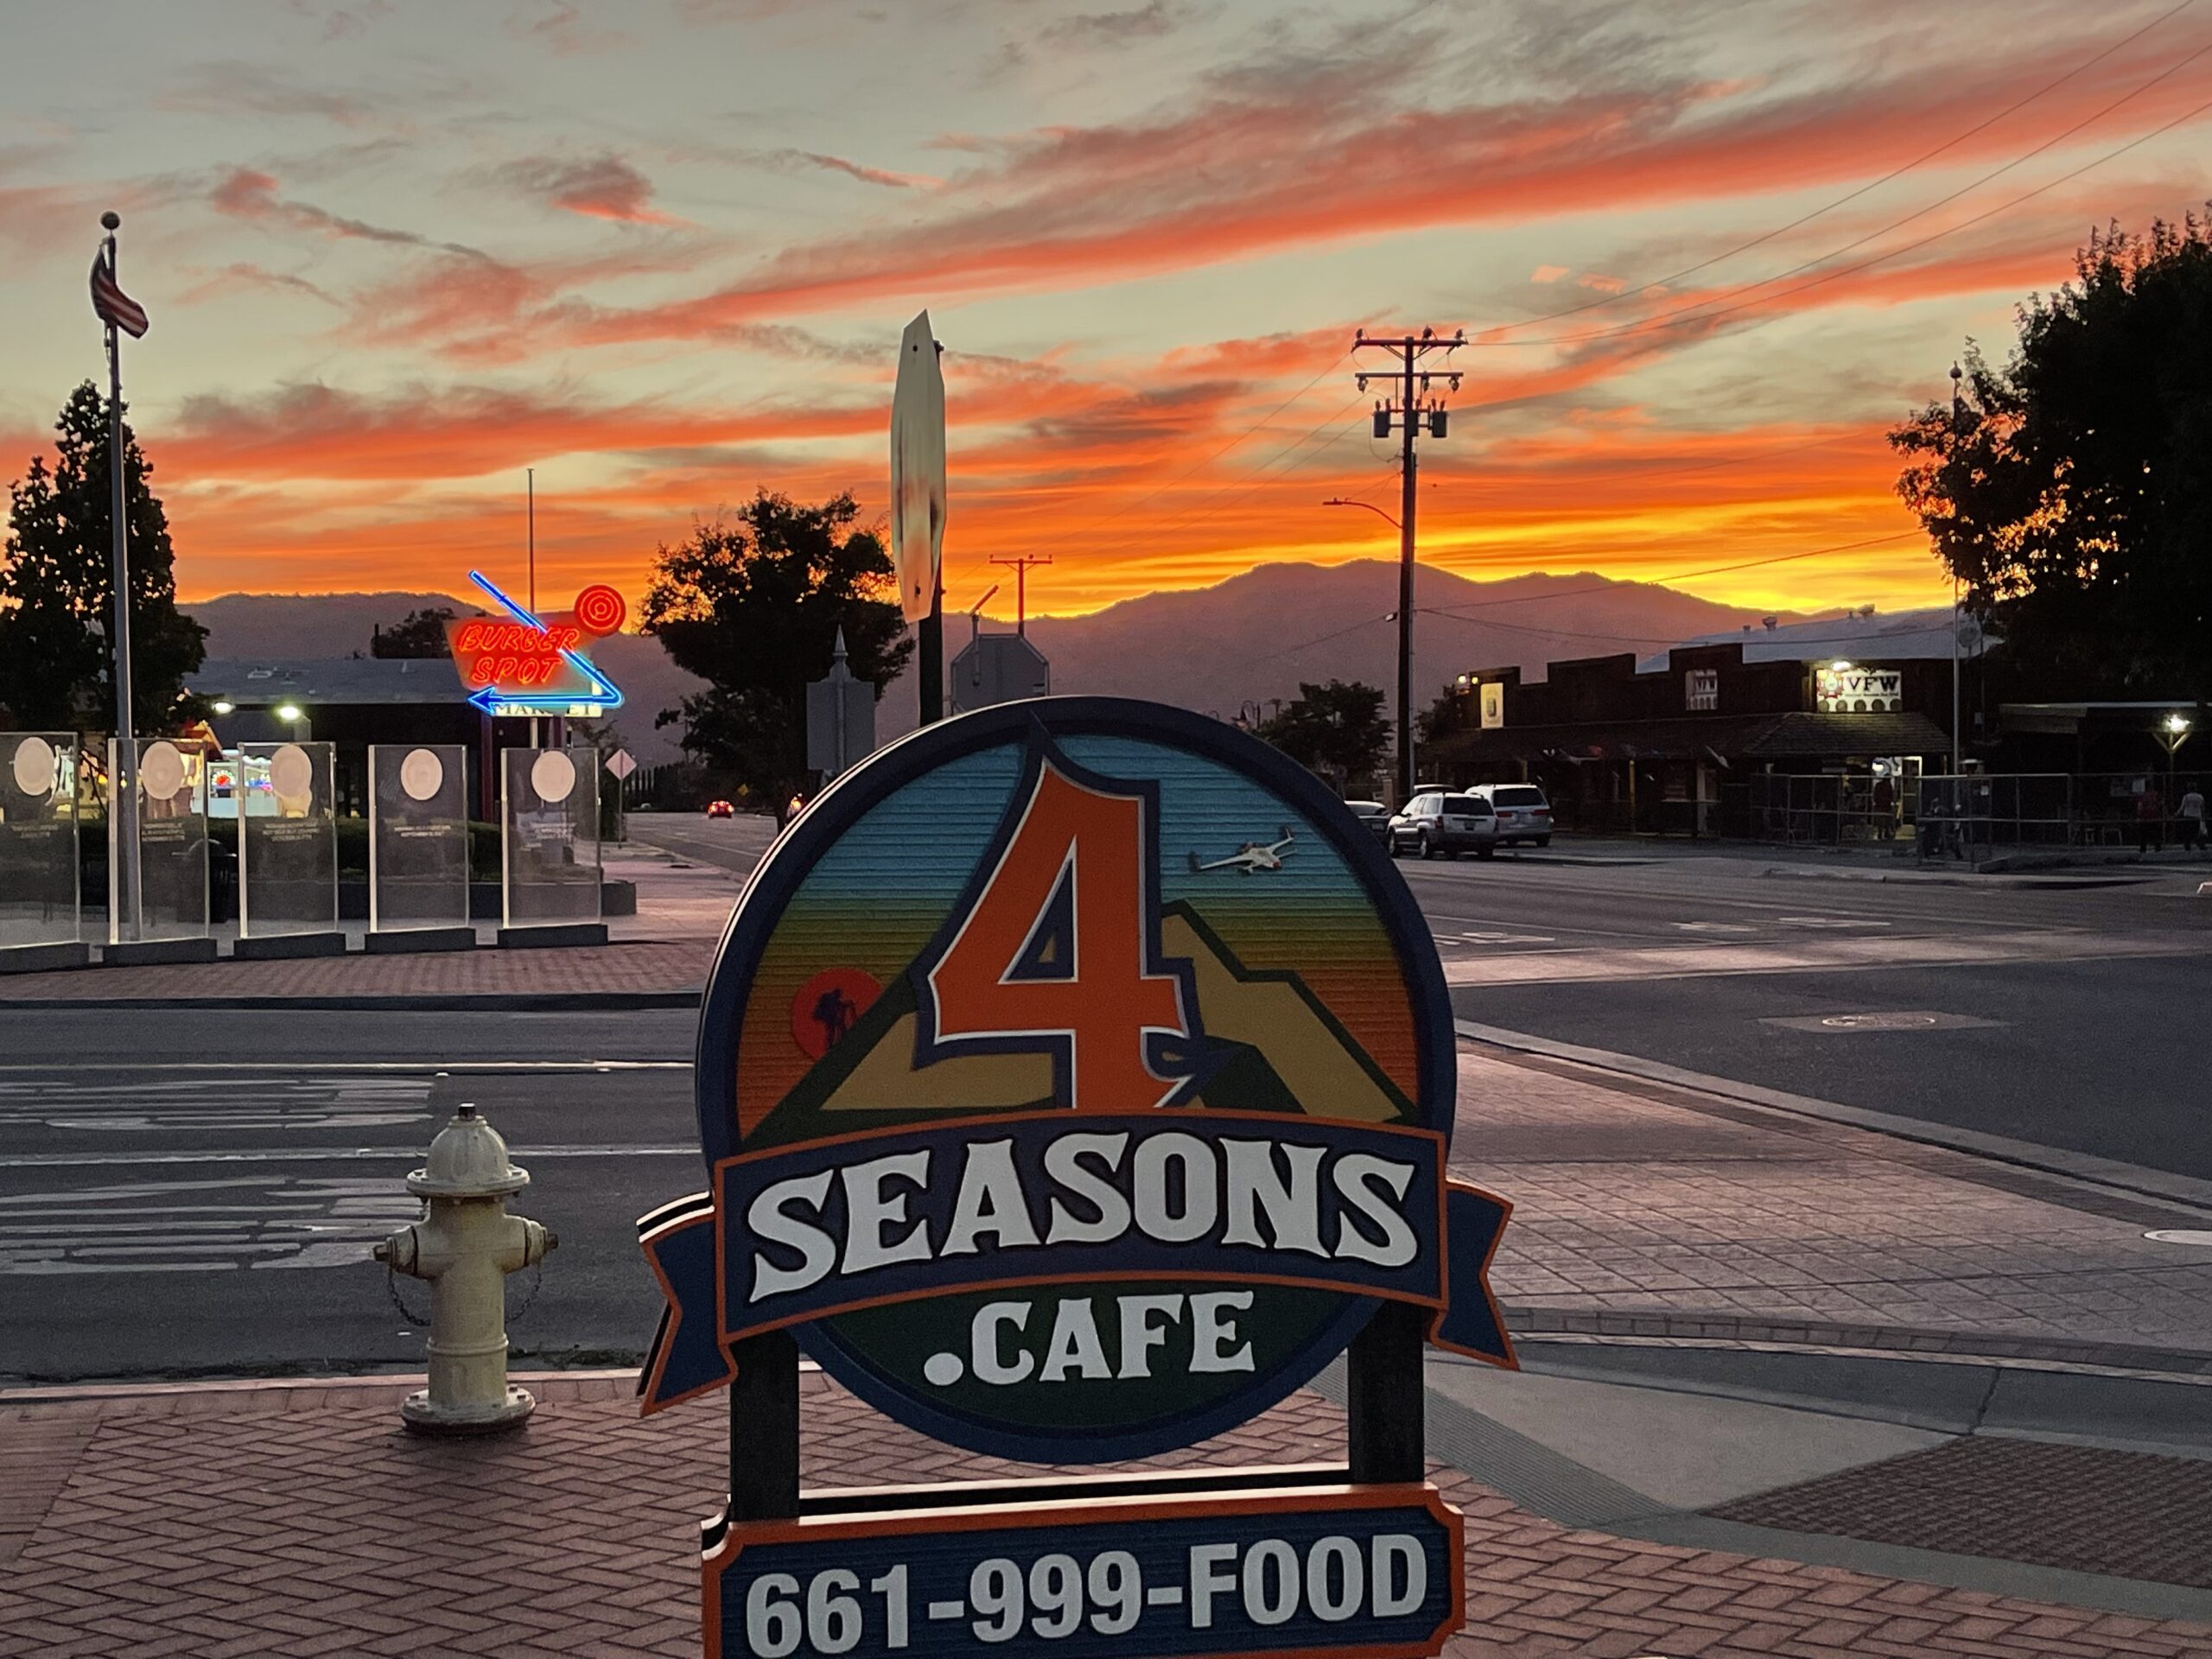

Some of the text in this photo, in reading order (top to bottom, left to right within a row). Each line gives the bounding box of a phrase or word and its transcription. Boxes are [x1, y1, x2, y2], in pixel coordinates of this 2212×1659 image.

[459, 624, 580, 653] BURGER
[471, 657, 563, 684] SPOT
[1847, 676, 1898, 691] VFW
[928, 754, 1191, 1109] 4
[748, 1131, 1418, 1303] SEASONS
[924, 1290, 1255, 1386] .CAFE
[747, 1533, 1428, 1658] 661-999-FOOD
